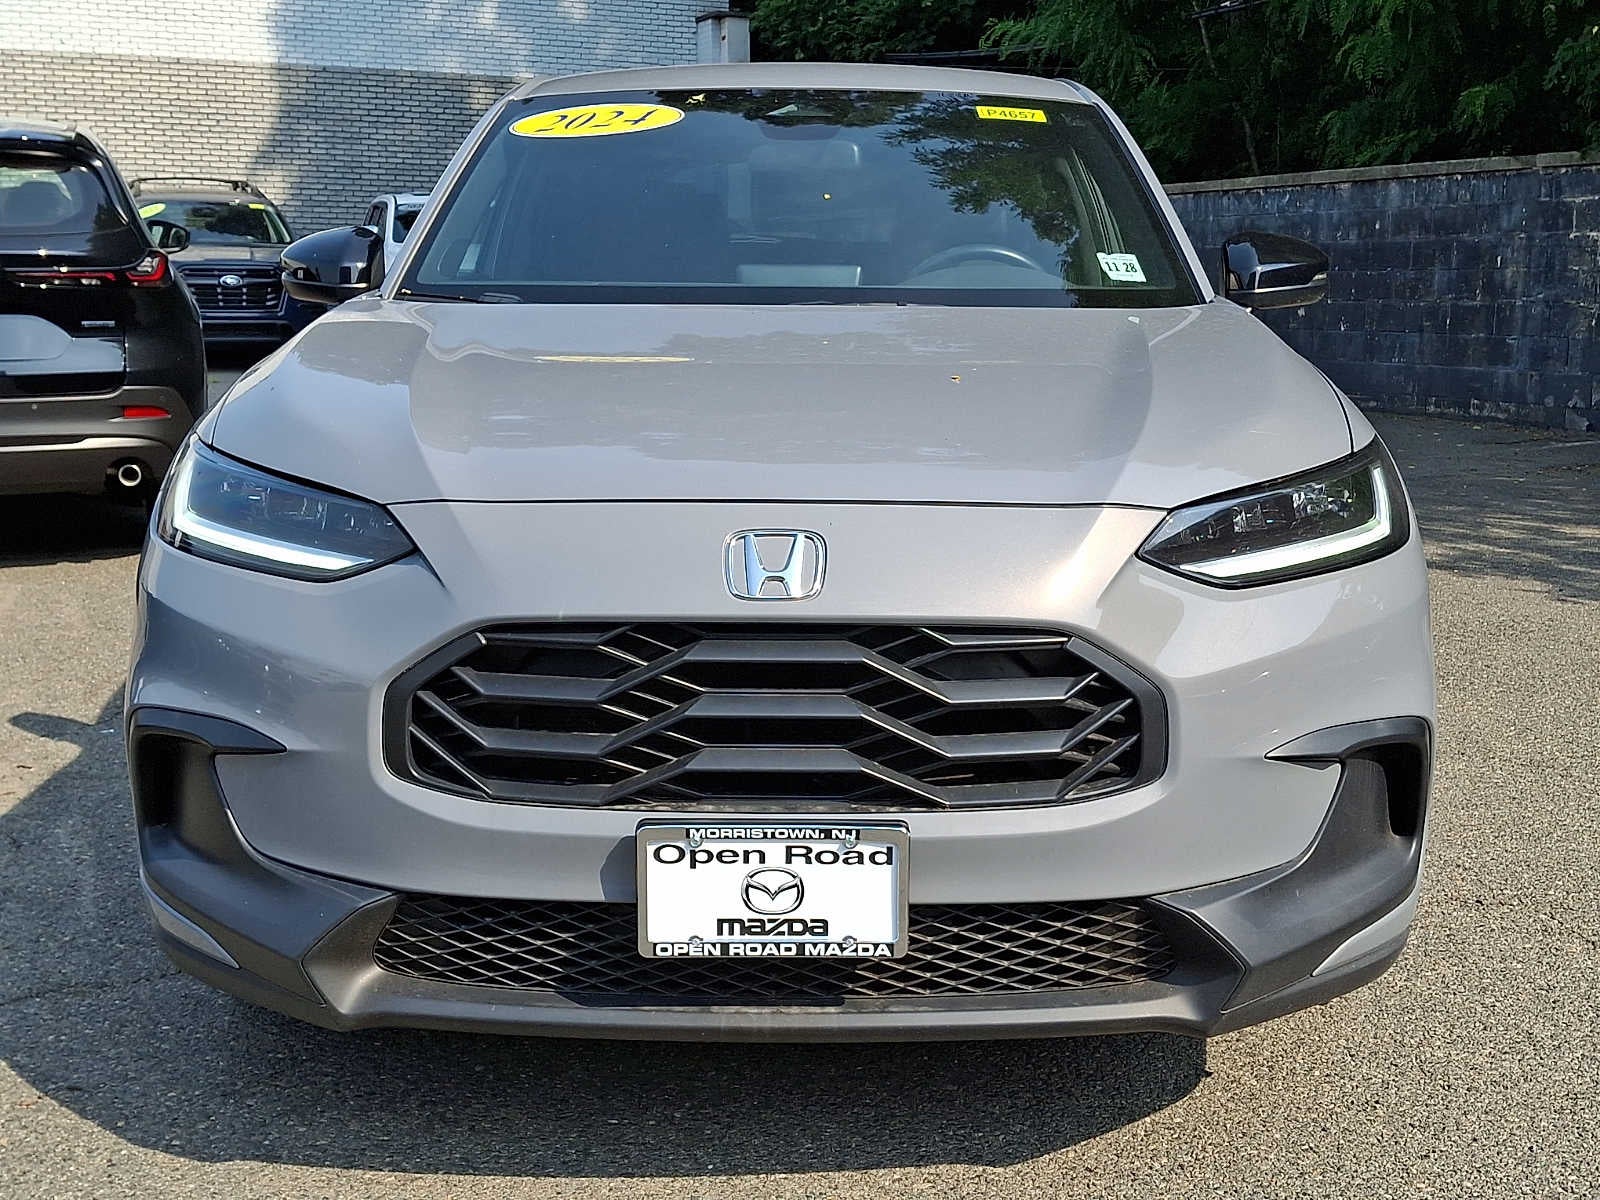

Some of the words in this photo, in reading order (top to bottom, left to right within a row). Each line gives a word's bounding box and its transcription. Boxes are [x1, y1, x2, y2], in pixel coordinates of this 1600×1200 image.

[533, 108, 659, 132] 2024
[986, 109, 1036, 119] P4657
[1104, 261, 1121, 272] 11
[1122, 262, 1138, 273] 28
[689, 828, 825, 839] MORRISTOWN,
[831, 829, 857, 841] NJ
[653, 844, 766, 869] Open
[785, 846, 893, 865] Road
[655, 943, 722, 956] OPEN
[729, 943, 798, 956] ROAD
[804, 943, 892, 957] MAZDA
